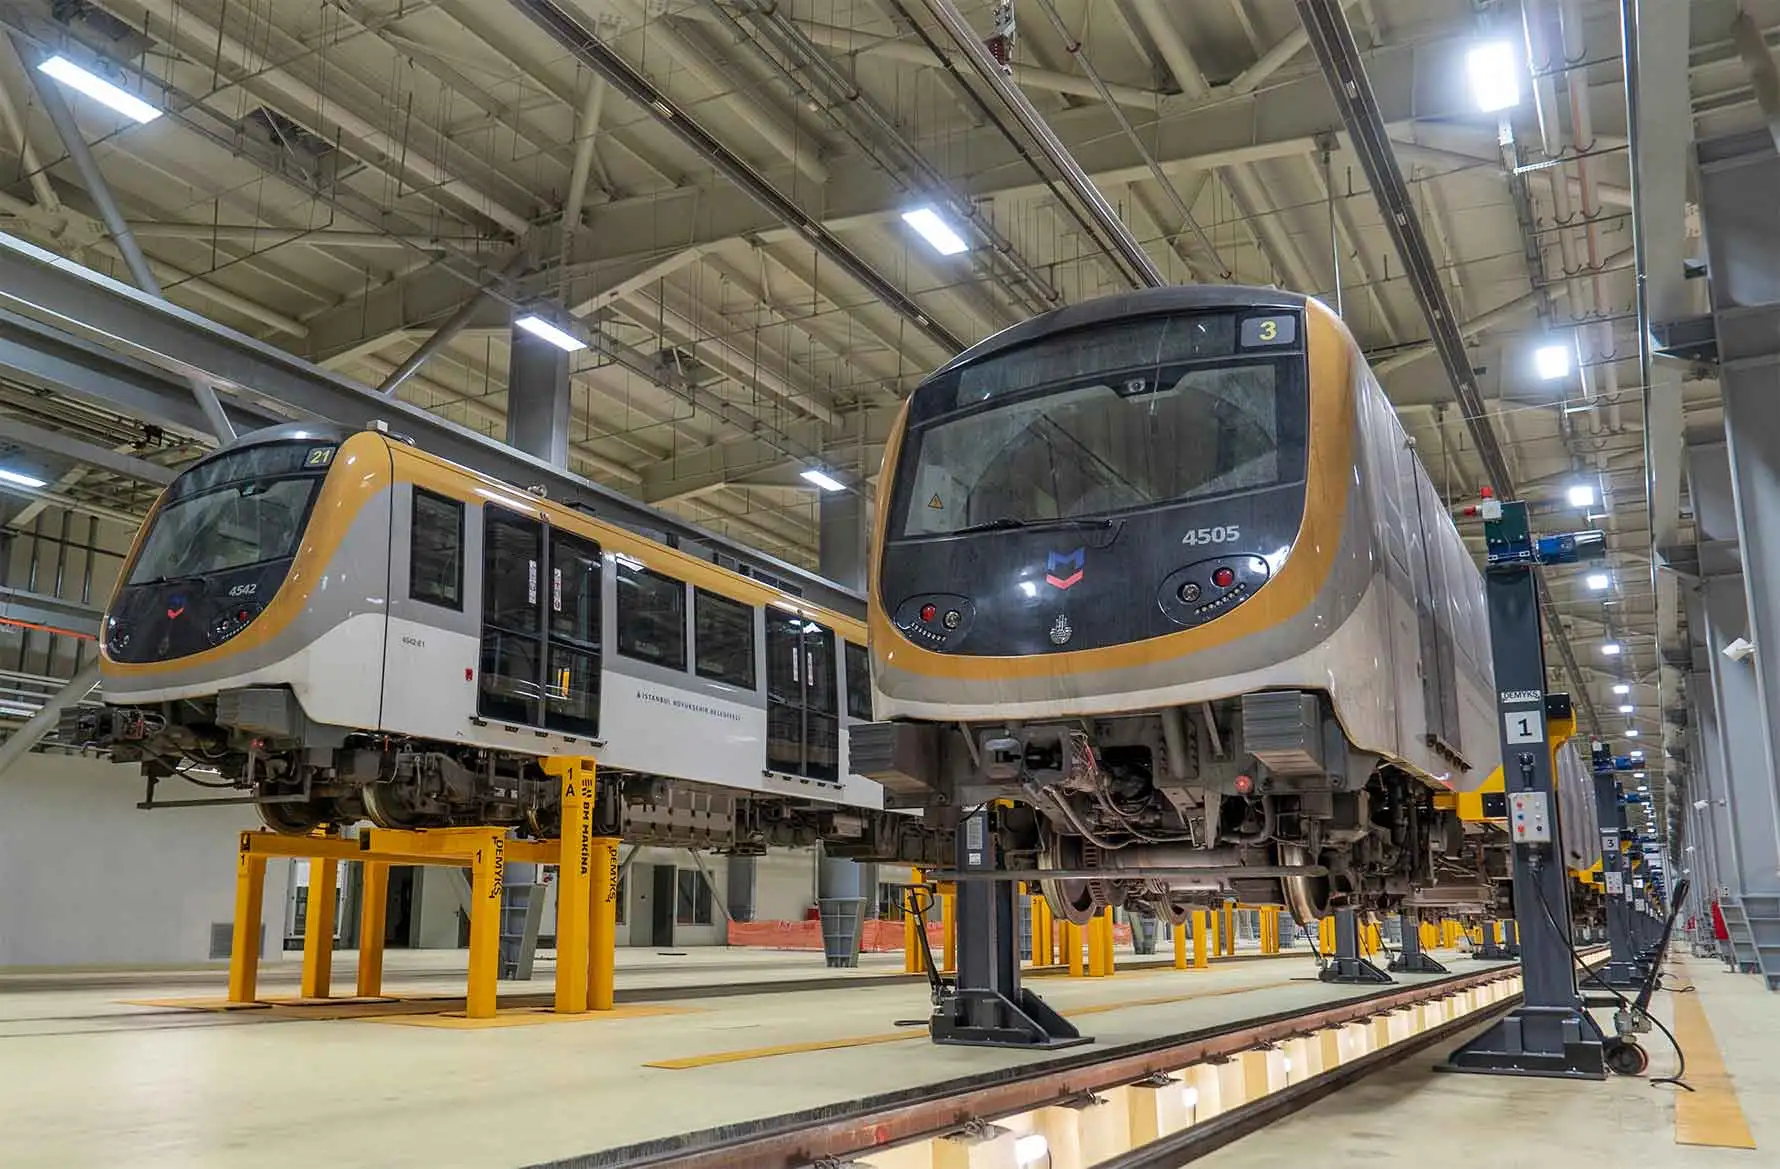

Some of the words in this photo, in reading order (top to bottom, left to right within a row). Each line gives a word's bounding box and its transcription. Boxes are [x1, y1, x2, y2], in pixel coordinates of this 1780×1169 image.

[1258, 320, 1277, 341] 3
[310, 450, 331, 464] 21
[1182, 525, 1240, 546] 4505
[228, 583, 257, 597] 4542
[1503, 691, 1539, 700] DEMYKS
[1518, 718, 1532, 737] 1
[567, 768, 573, 781] 1
[565, 784, 576, 798] A
[582, 801, 590, 821] BM
[1607, 839, 1615, 848] 3
[476, 849, 483, 865] 1
[493, 839, 504, 896] DEMYKS
[609, 849, 617, 900] DEMYKS
